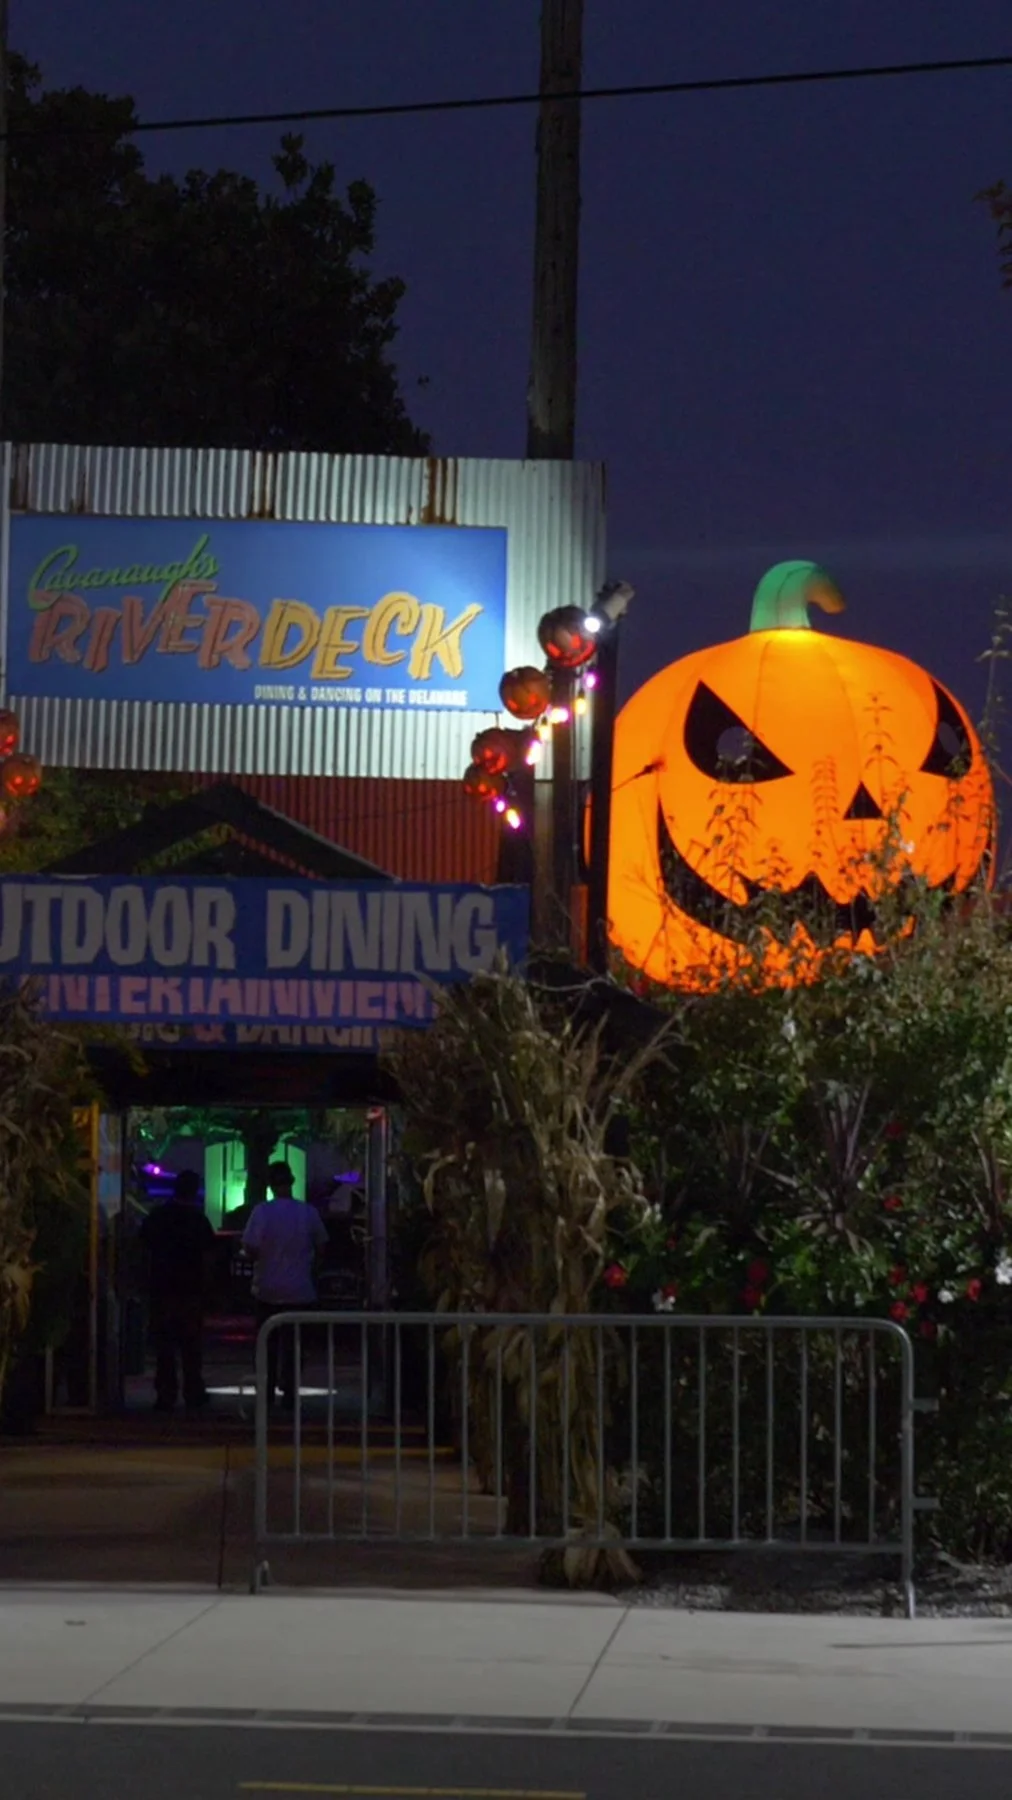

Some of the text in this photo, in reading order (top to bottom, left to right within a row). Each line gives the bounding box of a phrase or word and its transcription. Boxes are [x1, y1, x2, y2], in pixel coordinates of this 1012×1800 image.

[254, 685, 294, 700] DINING
[298, 686, 308, 701] &
[311, 686, 362, 702] DANCING
[365, 688, 382, 703] ON
[385, 689, 405, 704] THE
[265, 888, 498, 975] DINING
